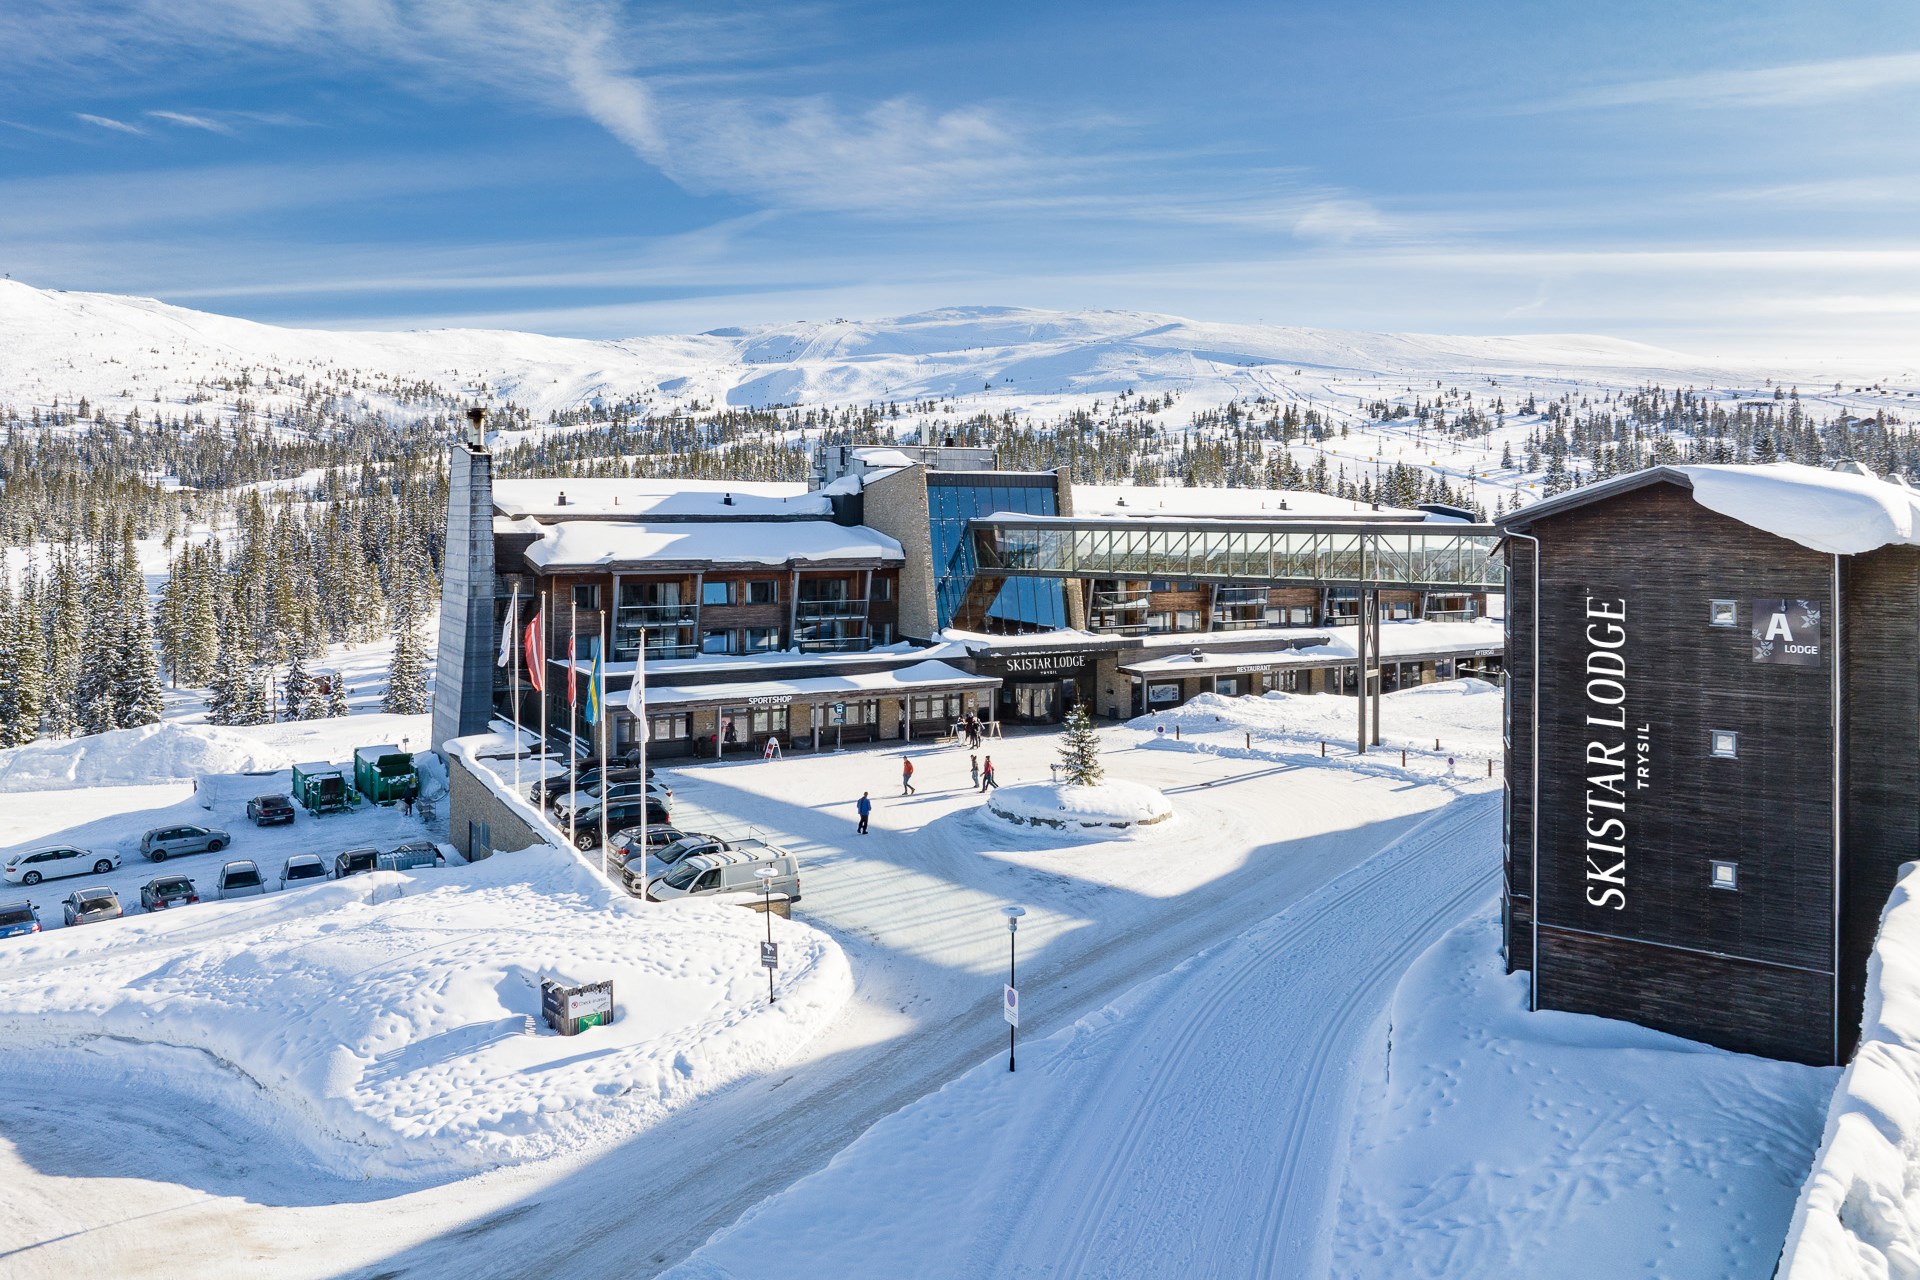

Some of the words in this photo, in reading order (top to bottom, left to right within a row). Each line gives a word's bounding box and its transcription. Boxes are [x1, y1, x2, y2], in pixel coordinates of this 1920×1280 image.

[1765, 612, 1794, 642] A
[1784, 644, 1818, 655] LODGE
[1006, 657, 1052, 672] SKISTAR
[1054, 655, 1086, 669] LODGE
[1236, 664, 1271, 673] RESTAURANT
[1587, 596, 1626, 731] LODGE
[748, 695, 793, 705] SPORTSHOP
[1636, 723, 1651, 790] TRYSIL
[1587, 741, 1626, 911] SKISTAR
